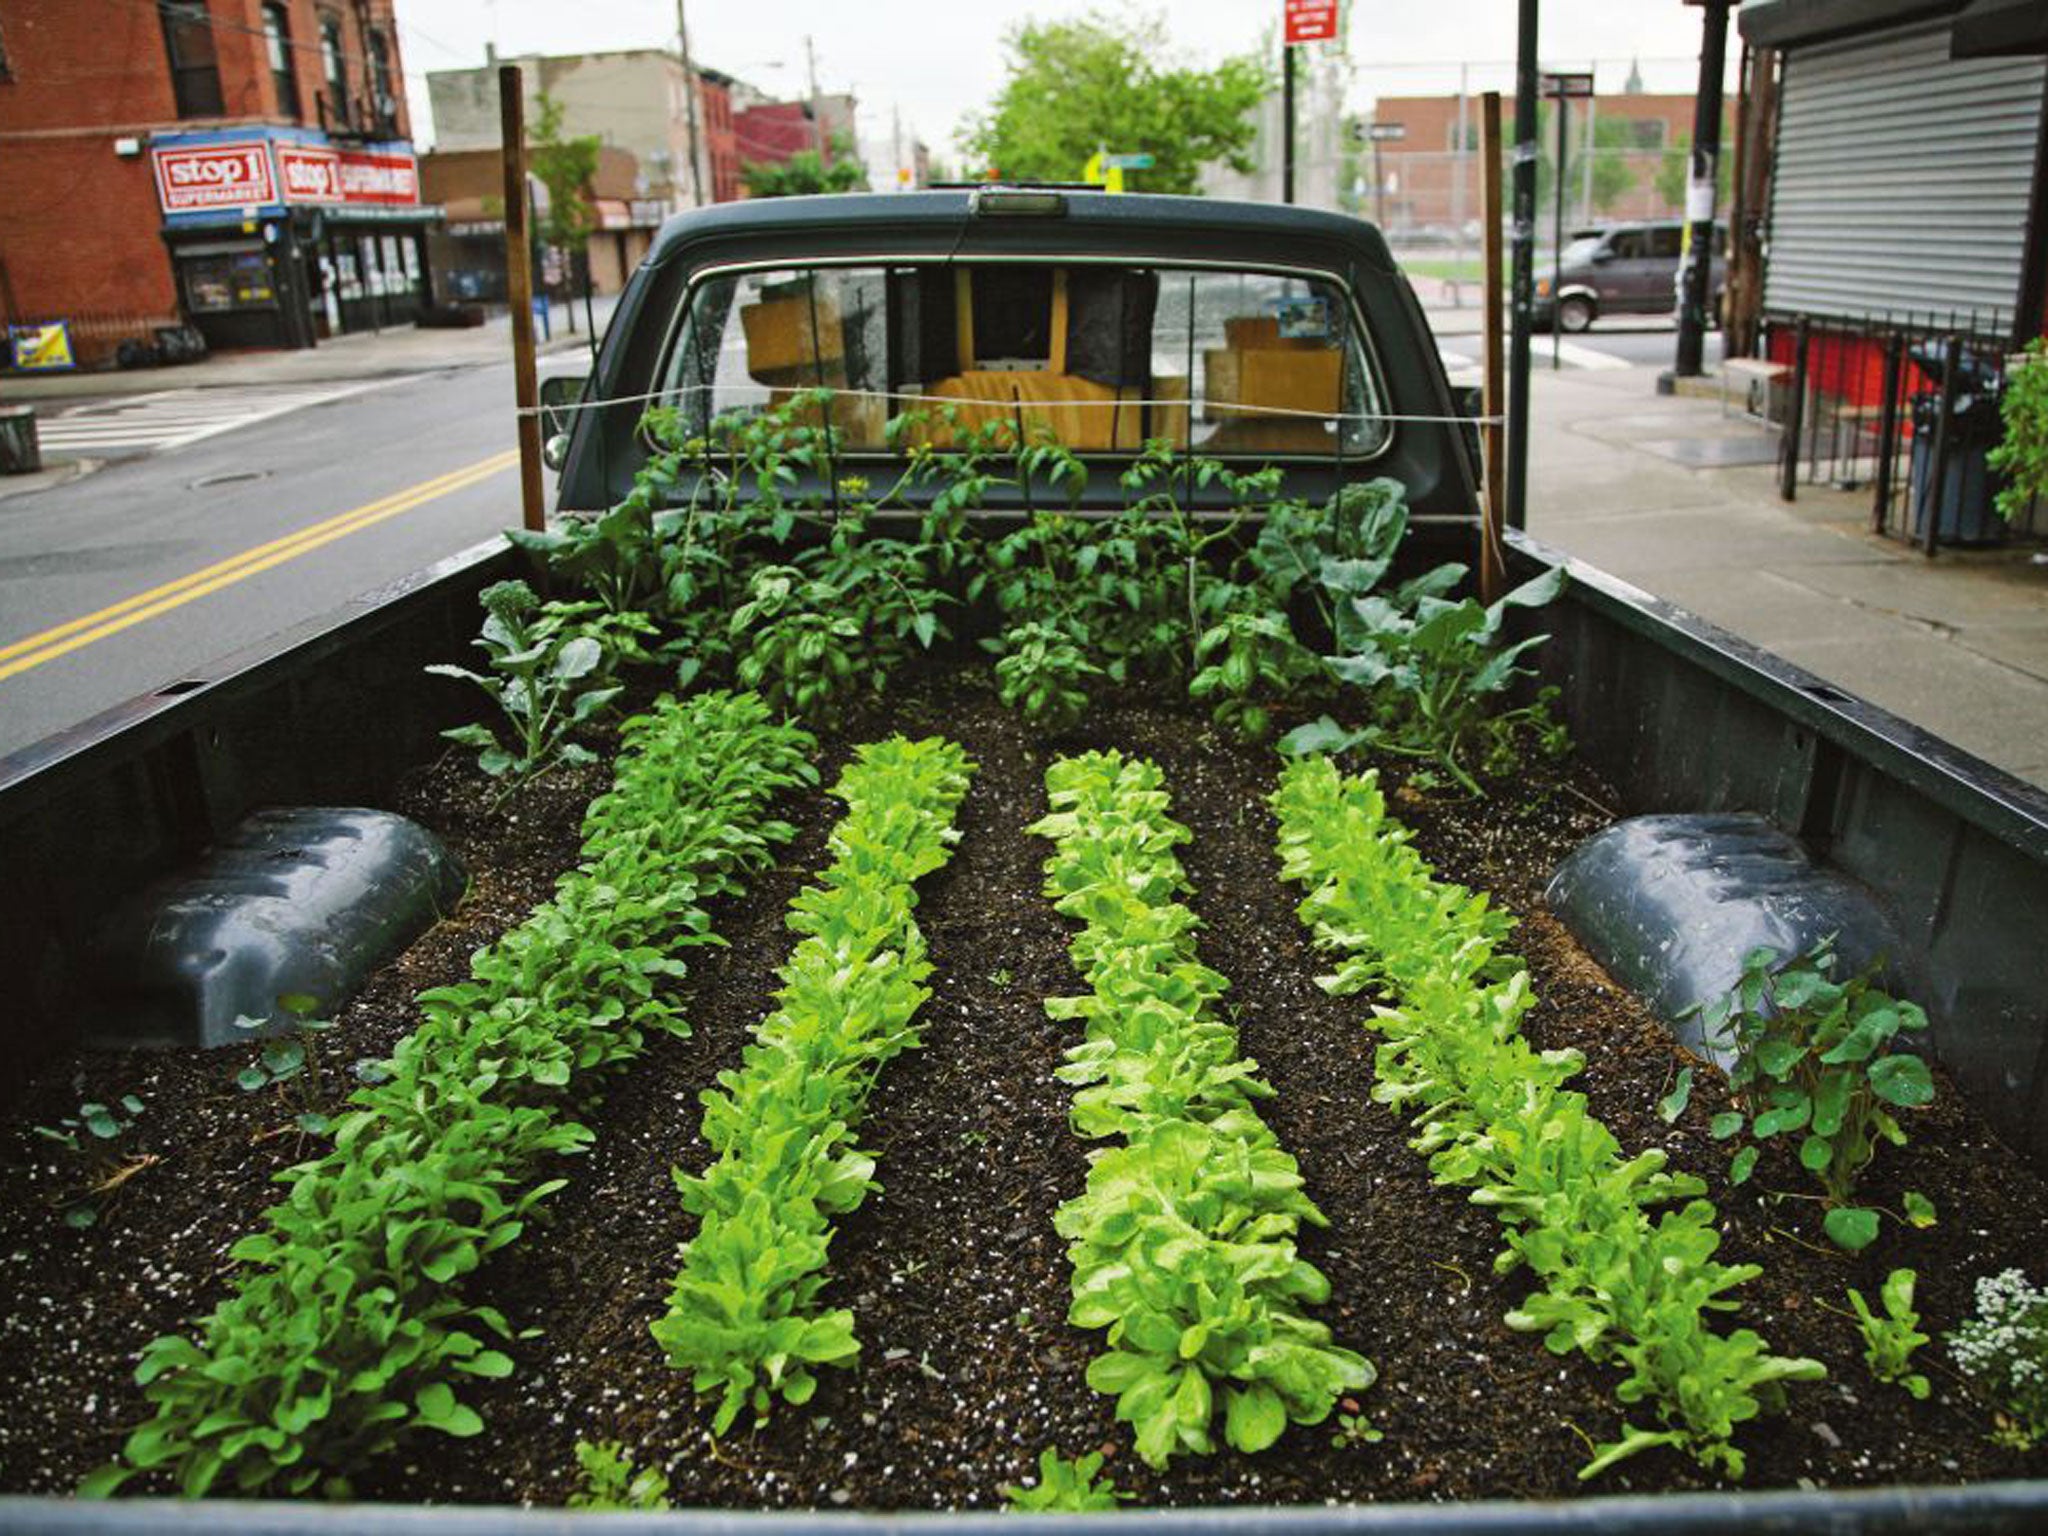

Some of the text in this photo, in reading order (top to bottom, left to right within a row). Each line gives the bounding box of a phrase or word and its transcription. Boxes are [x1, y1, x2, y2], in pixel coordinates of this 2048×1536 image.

[170, 153, 262, 187] stop 1
[286, 158, 328, 194] stop
